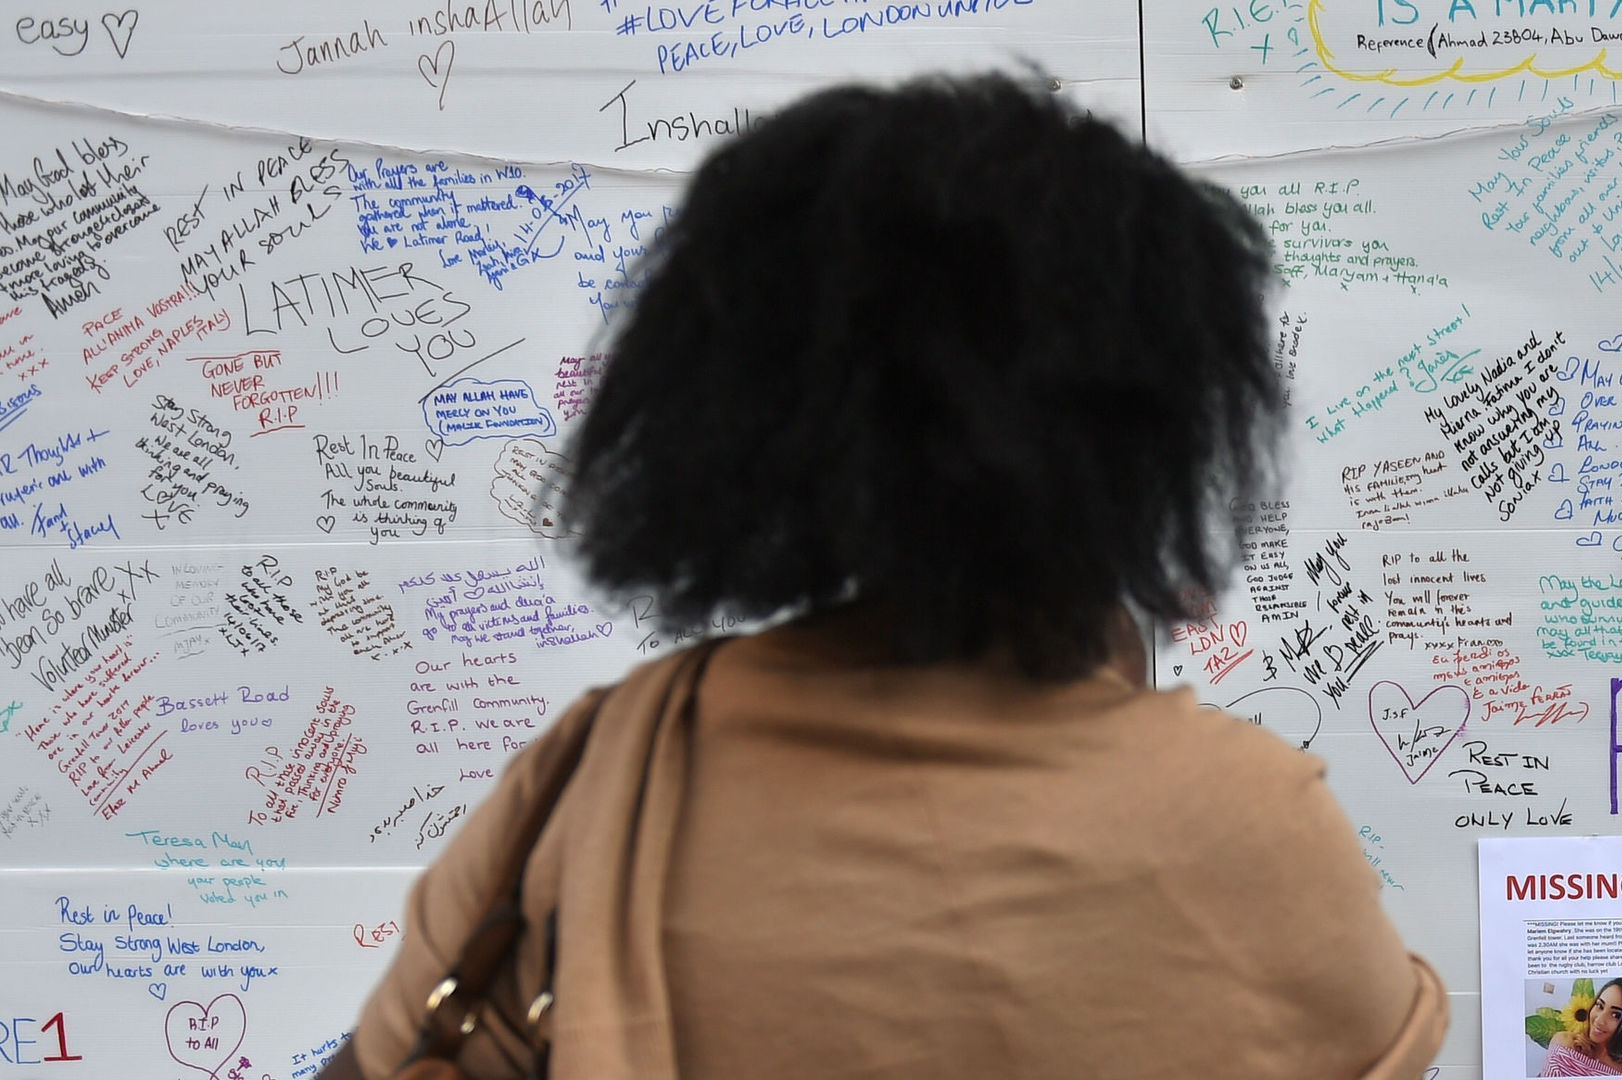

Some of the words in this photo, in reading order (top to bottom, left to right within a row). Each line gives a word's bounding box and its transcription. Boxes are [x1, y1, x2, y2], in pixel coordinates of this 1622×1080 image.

[16, 16, 89, 56] easy
[277, 20, 388, 75] Jannah
[1357, 34, 1424, 53] Reference
[1550, 27, 1584, 45] Abu
[238, 262, 445, 336] LATIMER
[327, 292, 472, 355] LOVES
[202, 357, 243, 379] GONE
[254, 352, 282, 368] BUT
[395, 328, 476, 378] YOU
[211, 375, 264, 398] NEVER
[434, 394, 458, 407] MAY
[462, 390, 496, 403] ALLAH
[499, 388, 529, 400] HAVE
[436, 408, 471, 420] MERCY
[475, 406, 491, 417] ON
[497, 404, 517, 416] YOU
[313, 434, 355, 465] Rest
[360, 434, 380, 460] In
[383, 435, 417, 463] Peace
[326, 462, 353, 480] All
[354, 465, 381, 492] you
[390, 465, 456, 493] beautiful
[321, 489, 346, 510] The
[353, 495, 390, 509] whole
[394, 499, 458, 522] community
[352, 511, 368, 523] is
[374, 513, 428, 536] thinking
[370, 526, 401, 546] you
[156, 691, 229, 717] Bassett
[237, 684, 290, 703] Road
[181, 717, 219, 732] loves
[231, 717, 259, 735] you
[1462, 740, 1519, 767] REST
[1522, 755, 1549, 770] IN
[1448, 769, 1539, 796] PEACE
[1455, 810, 1514, 830] ONLY
[1526, 797, 1573, 825] LOVE
[55, 896, 94, 925] Rest
[104, 903, 120, 923] in
[60, 932, 104, 971] Stay
[115, 935, 163, 963] Strong
[167, 936, 200, 955] West
[207, 935, 265, 953] London,
[106, 963, 152, 978] hearts
[164, 963, 187, 976] are
[201, 963, 234, 977] with
[185, 1037, 201, 1050] to
[204, 1036, 219, 1050] All
